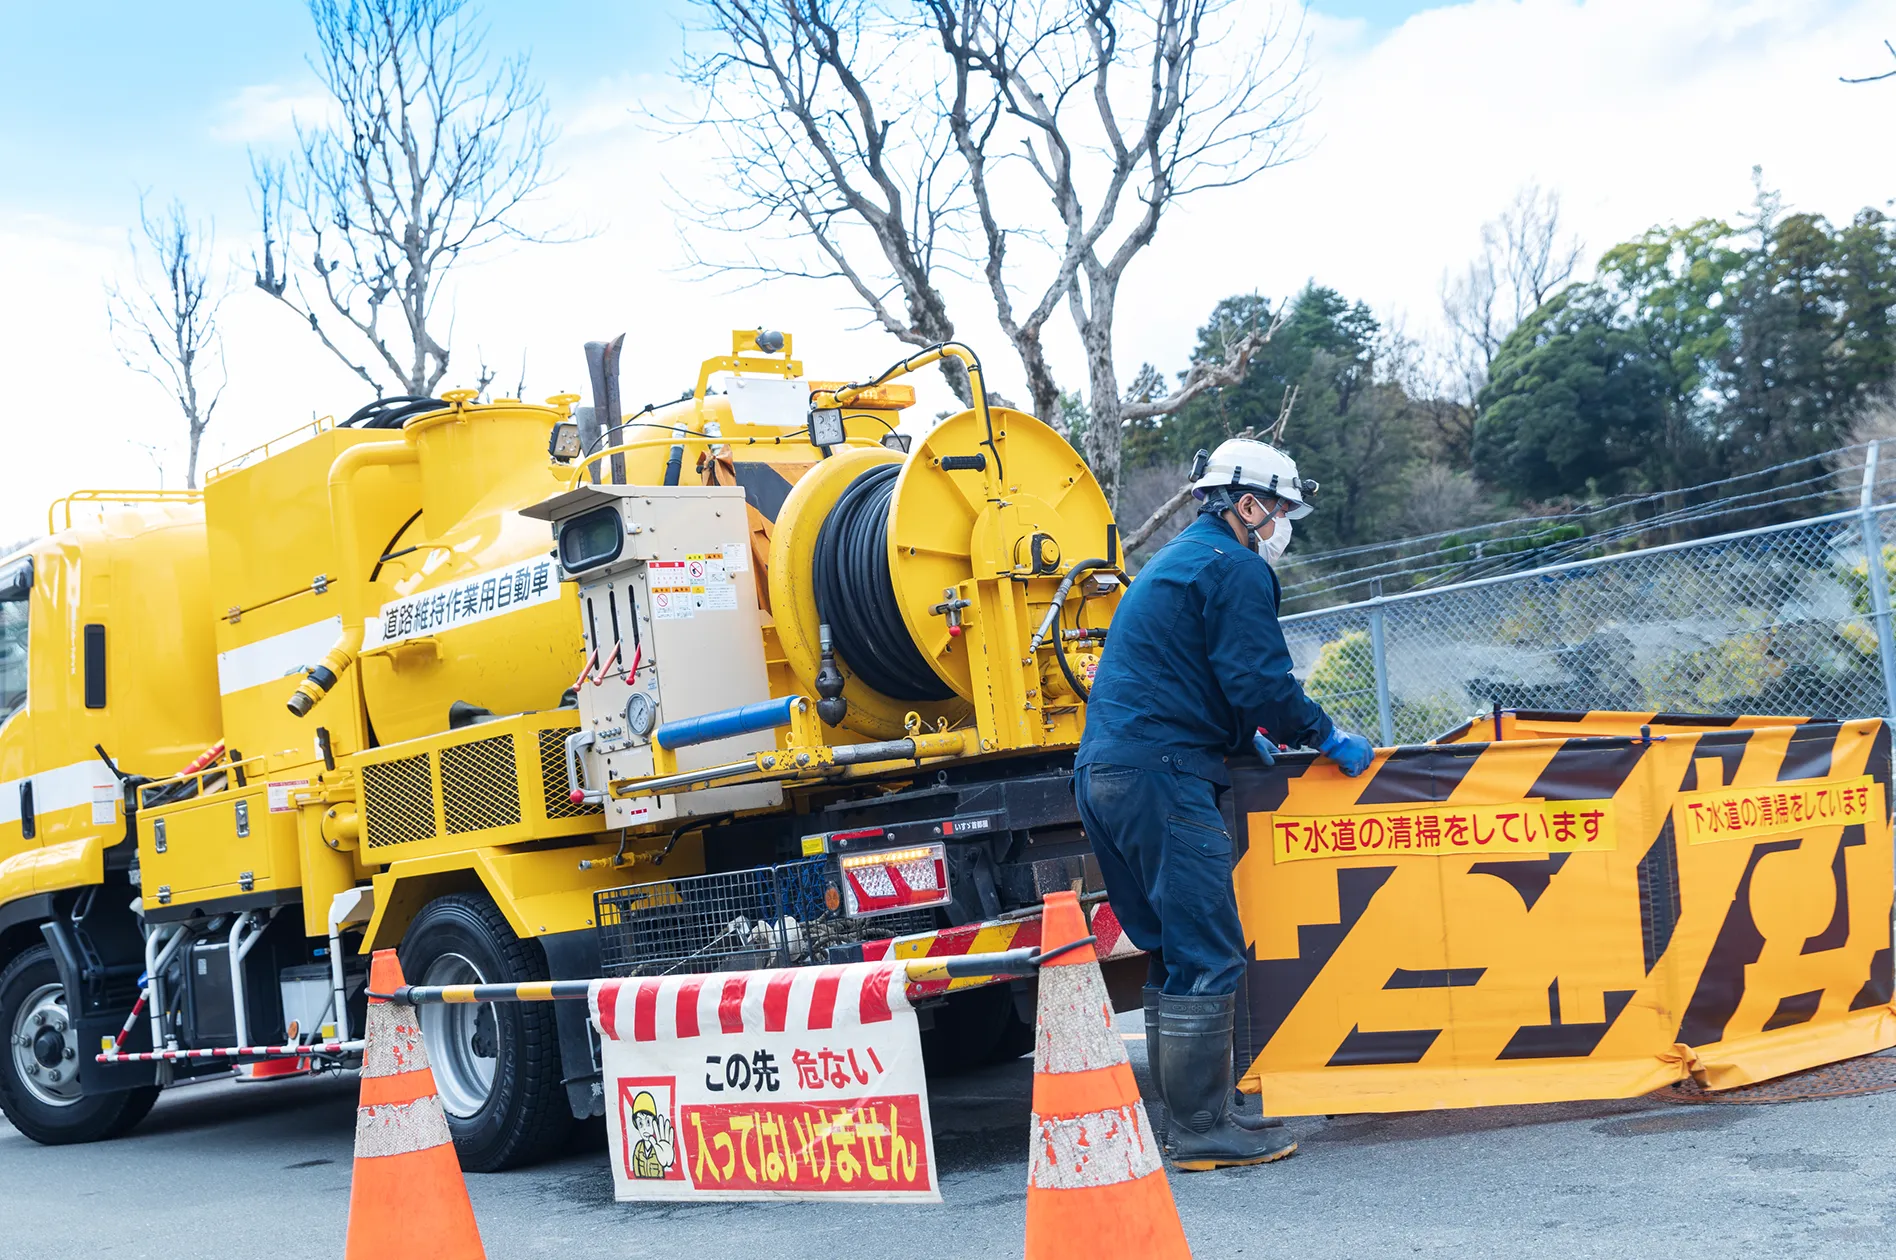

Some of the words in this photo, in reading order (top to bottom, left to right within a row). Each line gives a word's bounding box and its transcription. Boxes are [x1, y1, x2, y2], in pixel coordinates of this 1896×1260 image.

[383, 562, 549, 641] 道路維持作業用自動車
[1275, 809, 1604, 853] 下水道の清掃をしています
[1688, 788, 1868, 834] 下水道の清掃をしています
[706, 1049, 780, 1092] この先
[792, 1047, 884, 1090] 危ない
[691, 1103, 917, 1184] 入ってはいけません
